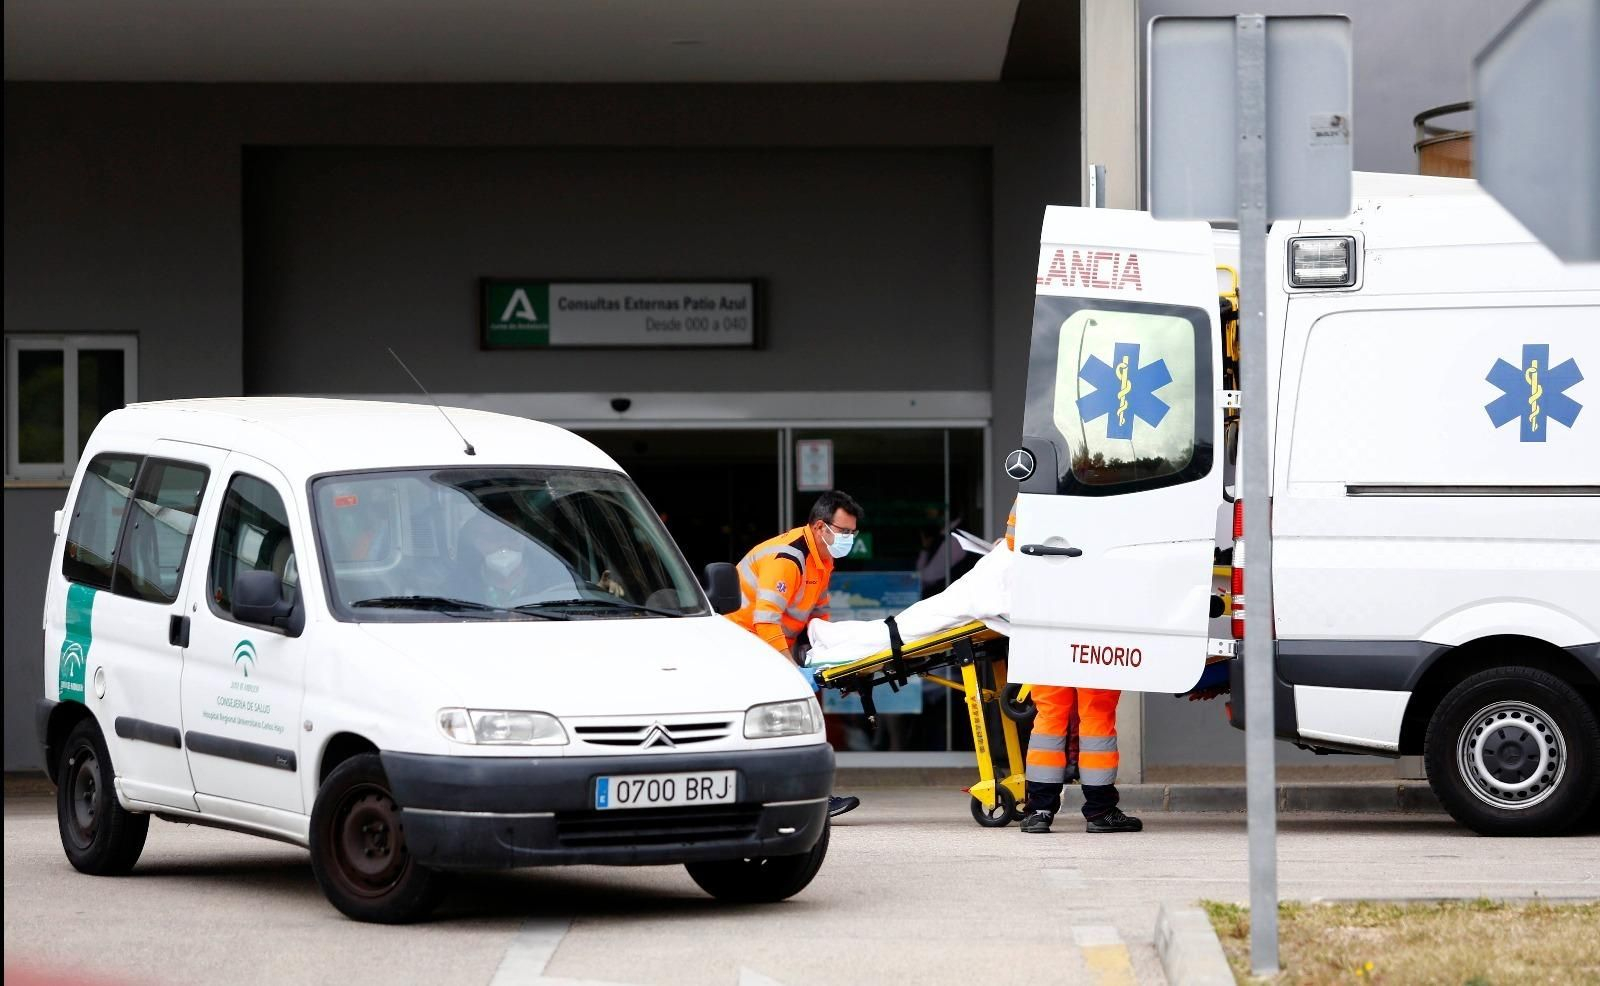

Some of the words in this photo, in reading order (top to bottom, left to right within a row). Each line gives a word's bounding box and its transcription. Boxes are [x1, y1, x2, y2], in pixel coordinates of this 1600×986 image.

[557, 296, 620, 311] Consultas
[624, 296, 679, 311] Externas
[683, 296, 715, 311] Patio
[719, 296, 747, 311] Azul
[646, 317, 682, 332] Desde
[685, 317, 708, 332] 000
[712, 319, 720, 332] a
[723, 317, 747, 332] 040
[1070, 643, 1142, 668] TENORIO
[246, 701, 254, 712] DE
[254, 703, 271, 714] SALUD
[616, 778, 676, 804] 0700
[685, 775, 729, 802] BRJ
